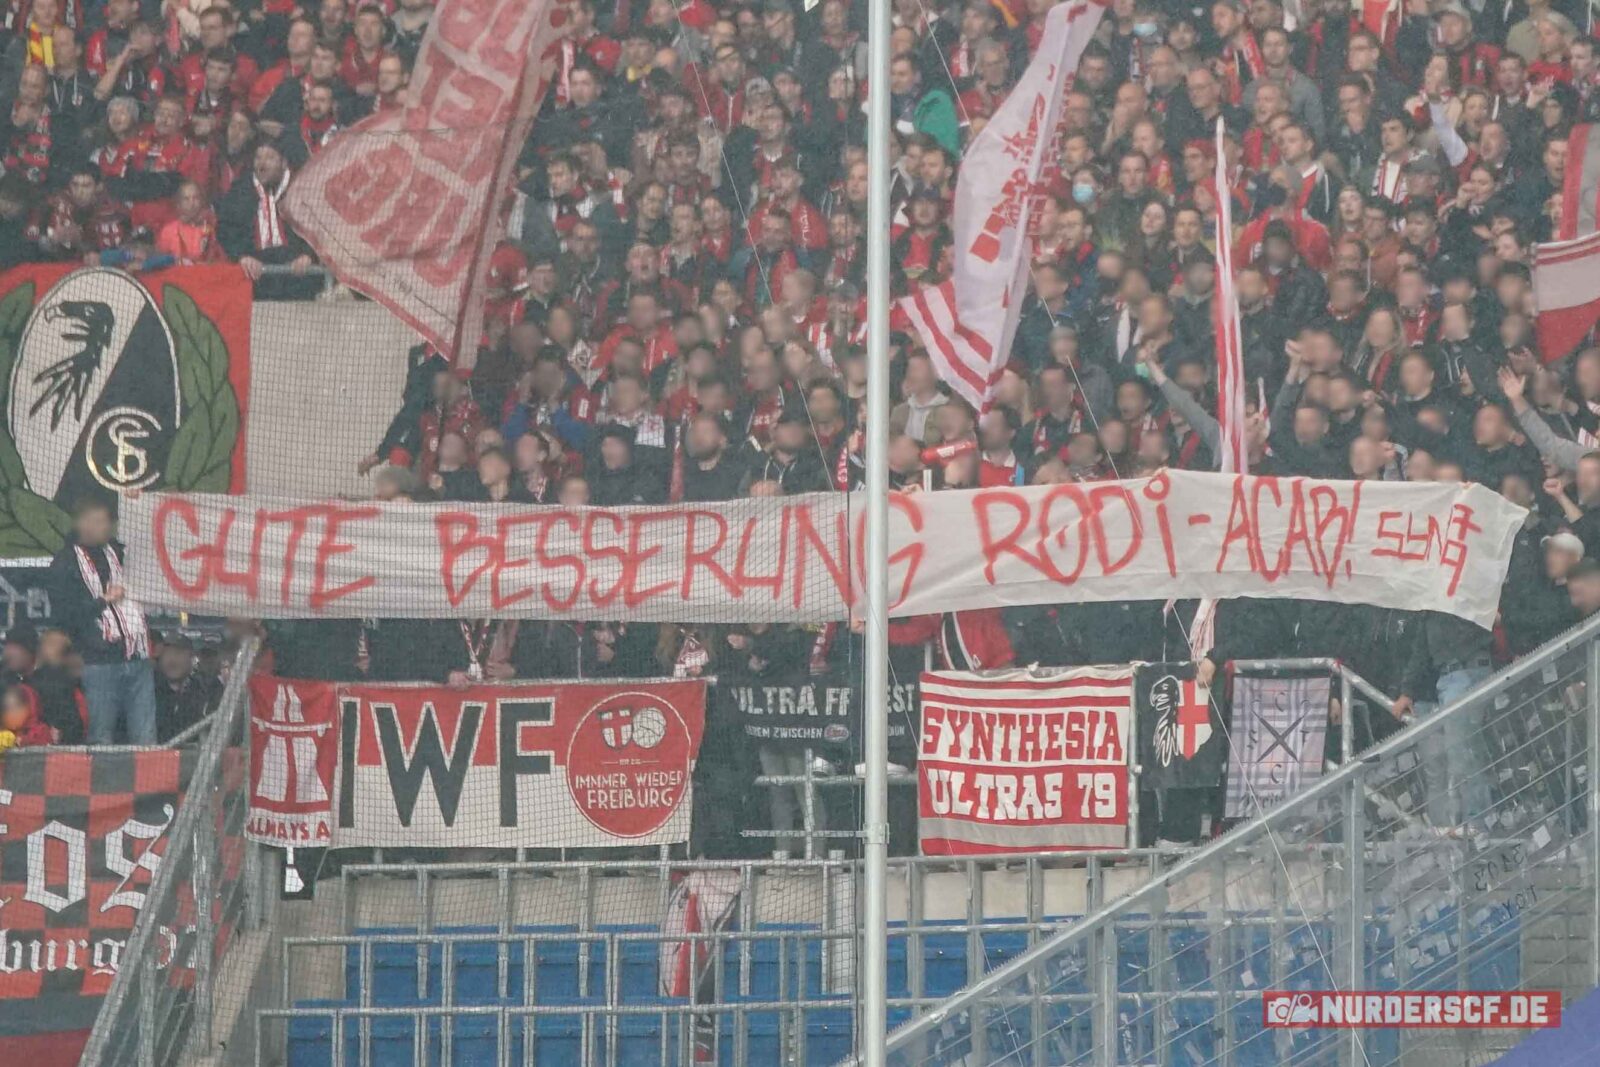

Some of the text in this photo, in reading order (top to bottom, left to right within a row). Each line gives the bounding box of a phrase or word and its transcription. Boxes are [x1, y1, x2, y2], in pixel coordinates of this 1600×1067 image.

[152, 496, 382, 611] GUTE
[434, 490, 924, 611] BESSERUNG
[922, 706, 1123, 761] SYNTHESIA
[339, 697, 555, 829] IWF
[635, 770, 683, 787] WIEDER
[587, 787, 675, 810] FREIBURG
[926, 768, 1117, 821] ULTRAS 79
